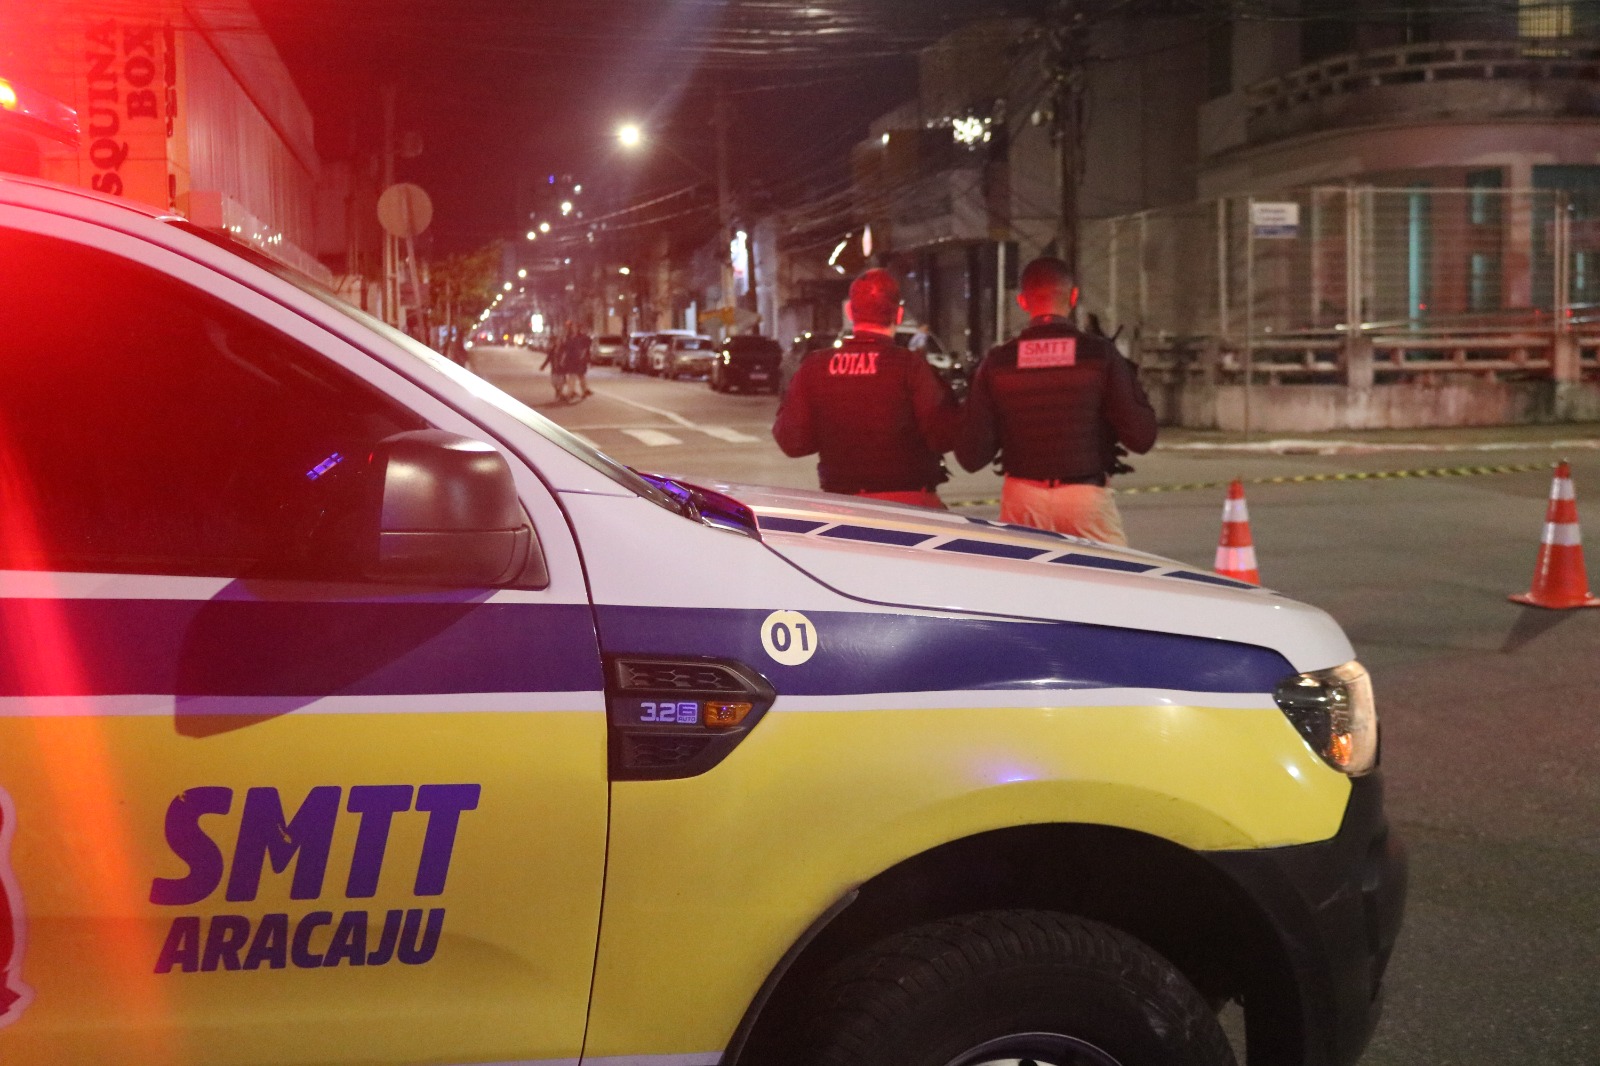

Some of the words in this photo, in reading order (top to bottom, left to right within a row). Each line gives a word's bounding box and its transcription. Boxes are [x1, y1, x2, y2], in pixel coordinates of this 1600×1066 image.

[122, 24, 158, 120] BOX
[829, 352, 879, 374] COTAX
[1024, 341, 1068, 355] SMTT
[770, 622, 809, 652] 01
[640, 702, 676, 721] 3.2
[149, 783, 481, 906] SMTT
[153, 908, 446, 974] ARACAJU
